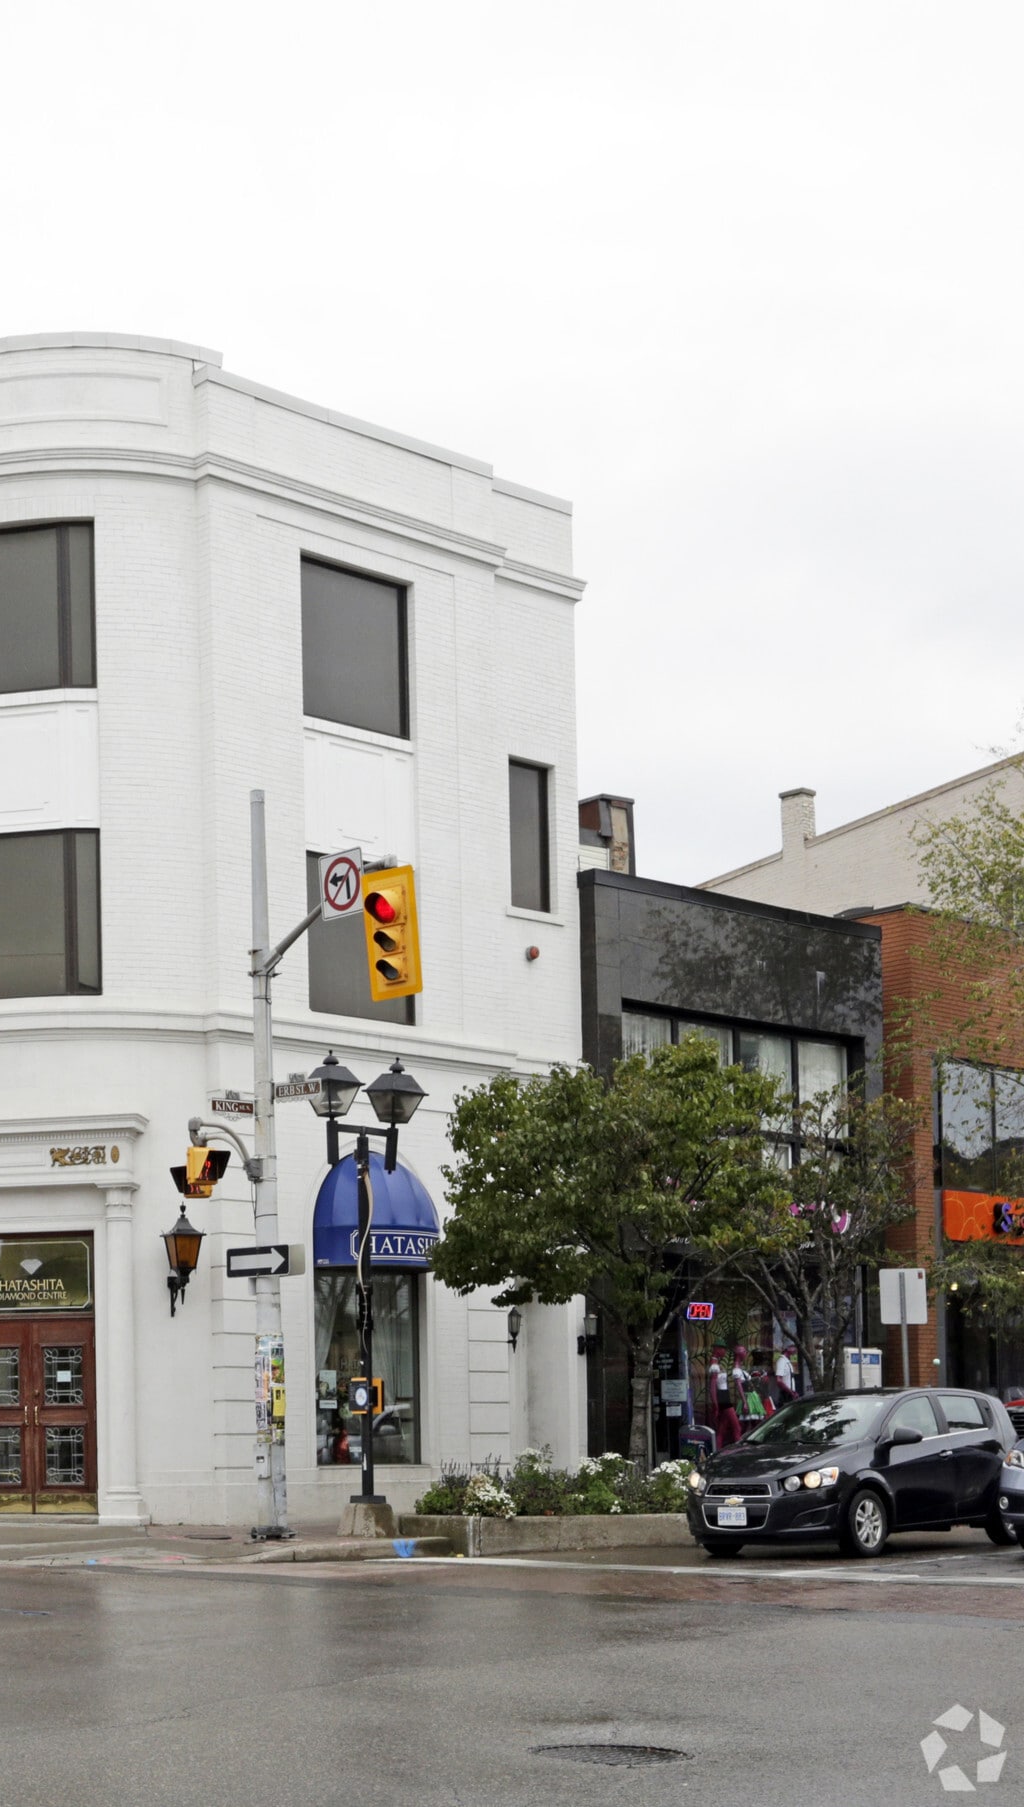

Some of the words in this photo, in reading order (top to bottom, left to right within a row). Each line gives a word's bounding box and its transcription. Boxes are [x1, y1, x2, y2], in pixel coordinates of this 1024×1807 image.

[278, 1085, 295, 1097] ERB
[216, 1101, 239, 1112] KING
[37, 1291, 68, 1300] CENTRE
[690, 1304, 711, 1317] OPEN
